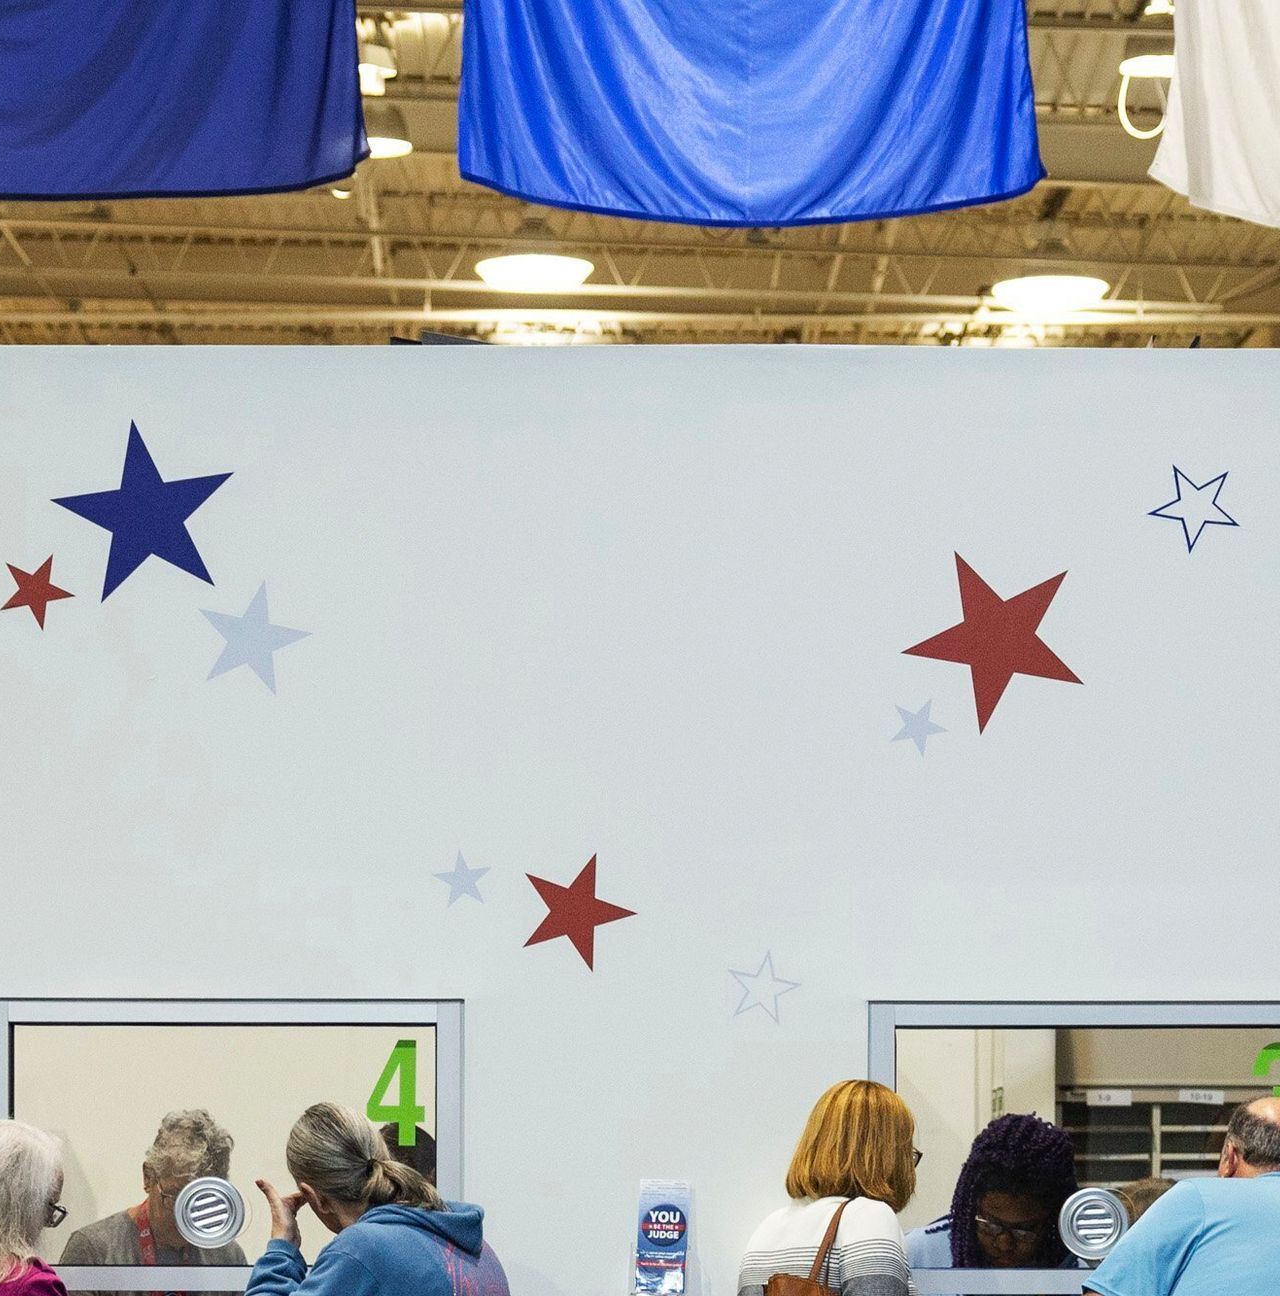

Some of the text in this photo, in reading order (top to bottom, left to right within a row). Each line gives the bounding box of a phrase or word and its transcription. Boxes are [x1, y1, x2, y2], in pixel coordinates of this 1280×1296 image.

[367, 1040, 425, 1146] 4
[650, 1210, 680, 1224] YOU
[662, 1223, 674, 1231] THE
[647, 1230, 680, 1240] JUDGE
